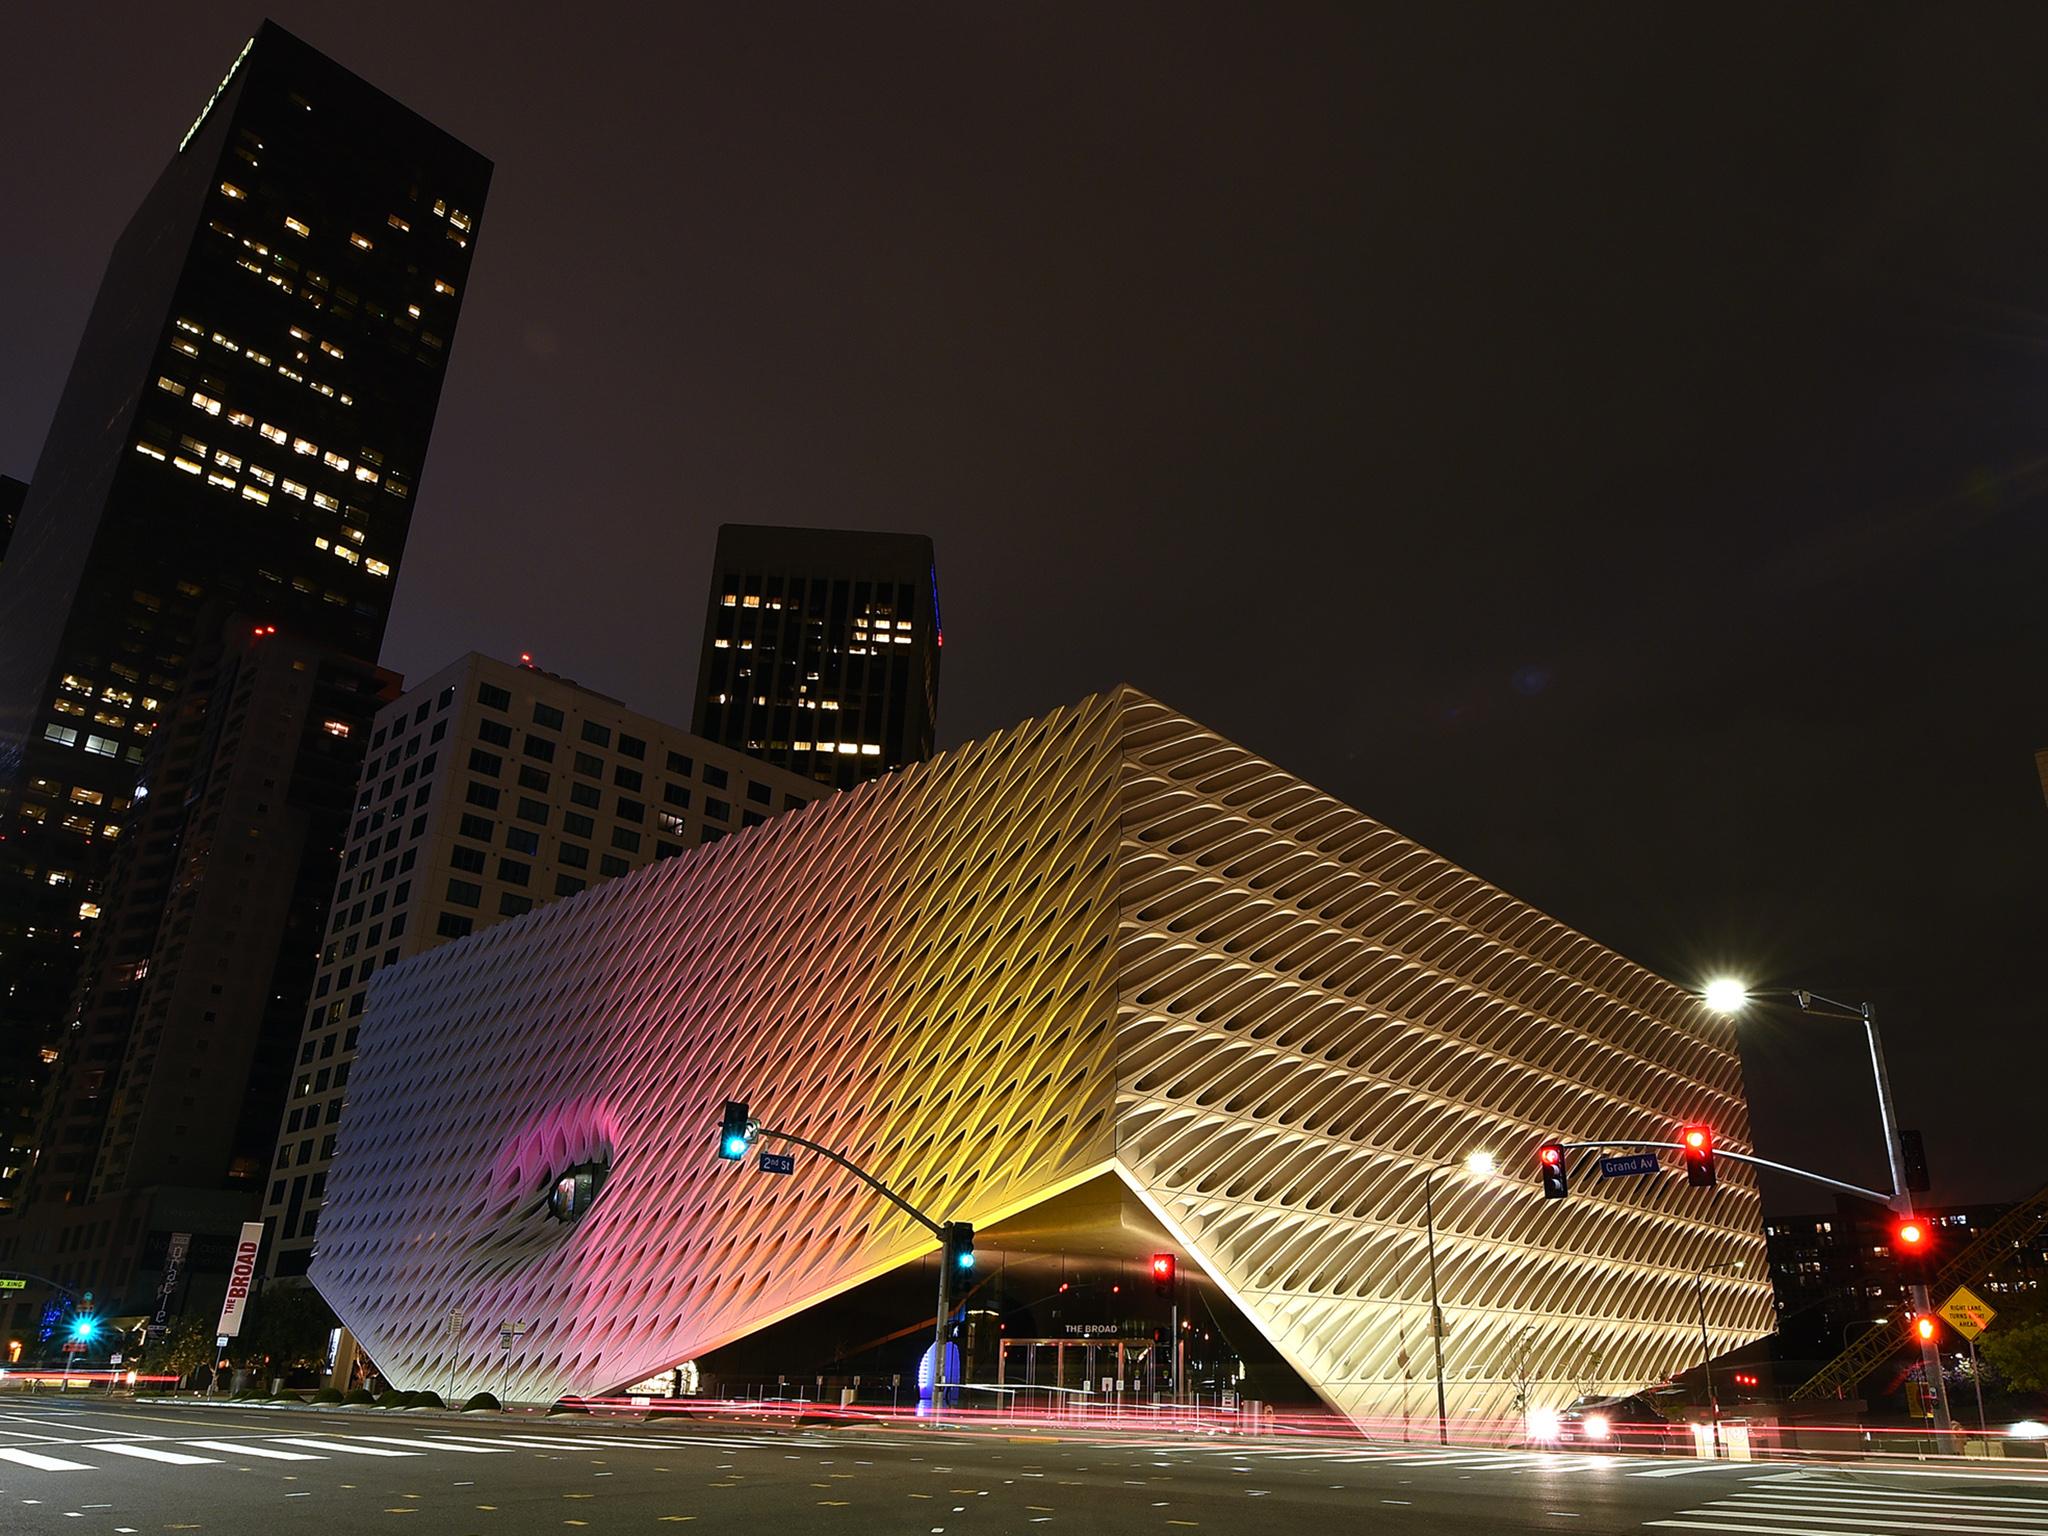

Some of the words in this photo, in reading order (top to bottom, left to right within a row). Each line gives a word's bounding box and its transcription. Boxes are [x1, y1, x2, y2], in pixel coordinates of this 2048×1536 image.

[763, 1157, 779, 1169] 2nd
[781, 1160, 790, 1171] St
[1606, 1159, 1637, 1172] Grand
[1640, 1158, 1653, 1169] Av
[229, 1241, 258, 1299] BROAD
[225, 1298, 237, 1315] THE
[1065, 1324, 1083, 1333] THE
[1085, 1324, 1118, 1333] BROAD
